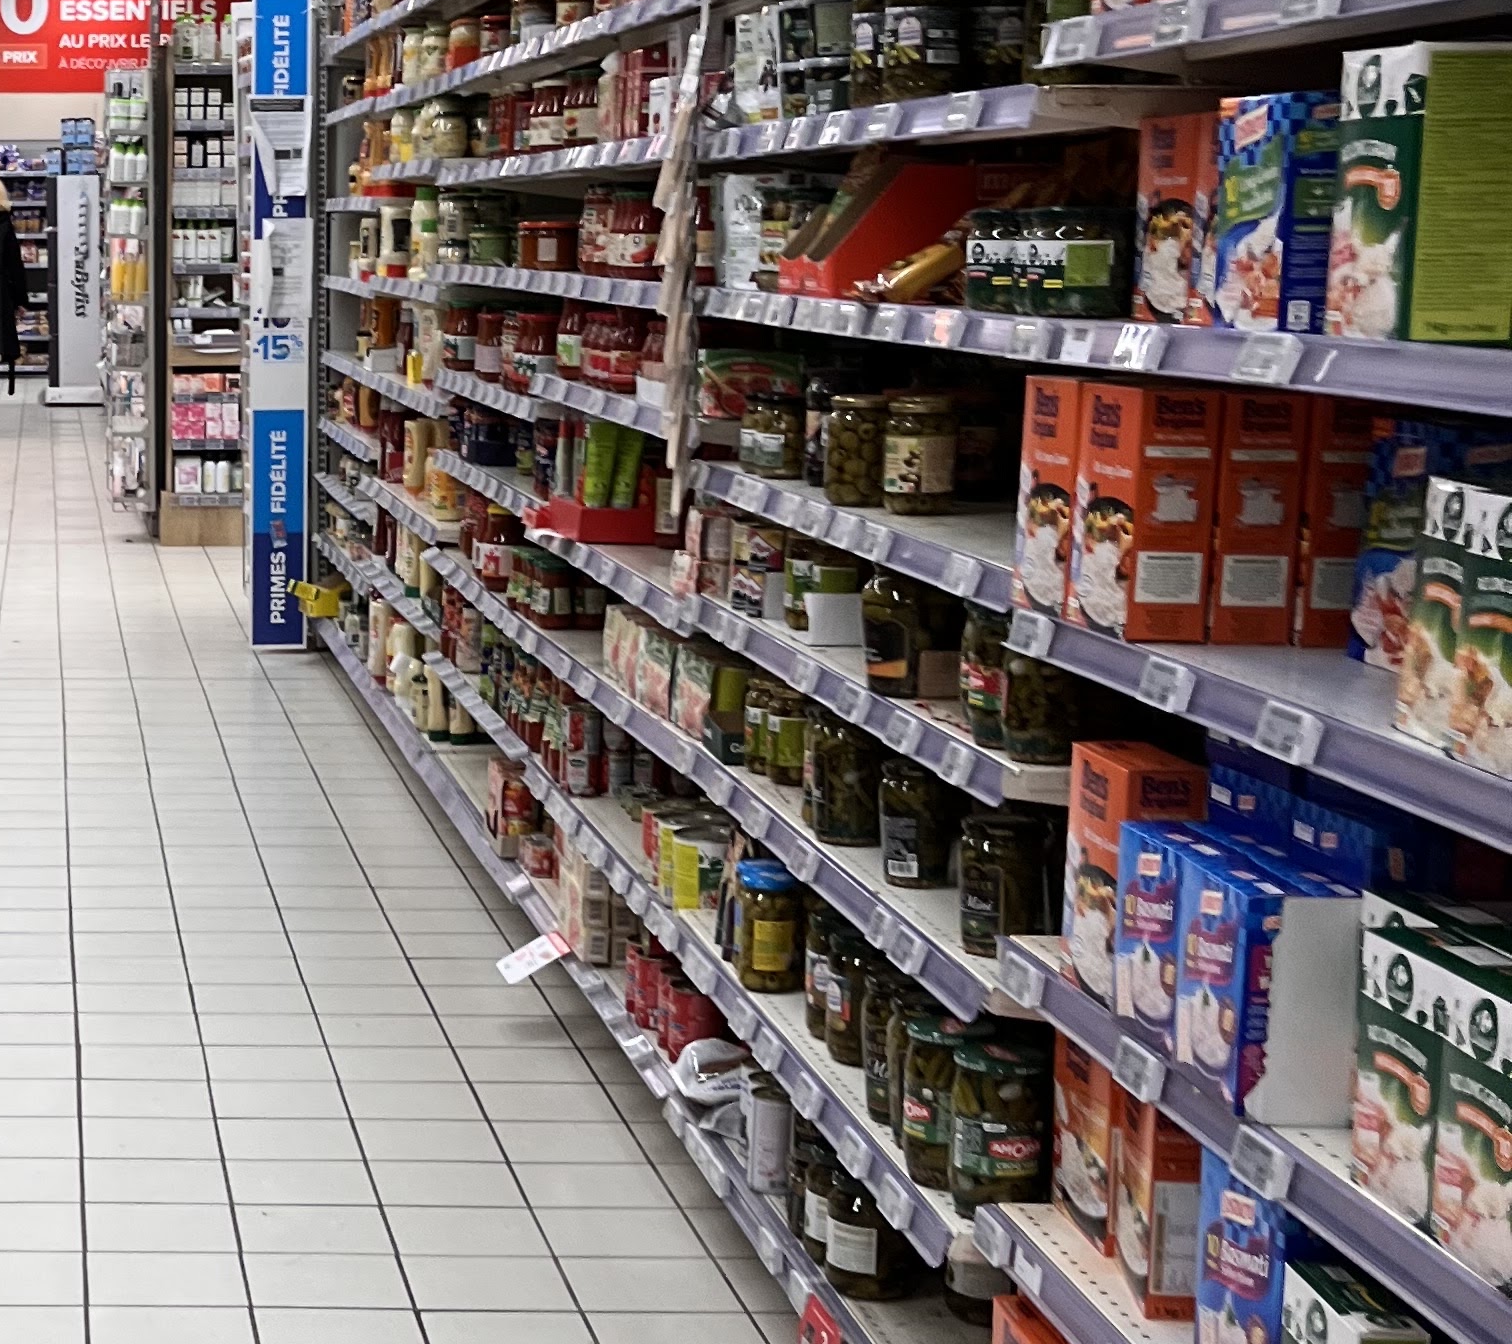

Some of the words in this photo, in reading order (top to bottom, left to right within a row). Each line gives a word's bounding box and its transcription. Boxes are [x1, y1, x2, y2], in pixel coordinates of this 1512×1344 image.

[59, 0, 217, 23] ESSENIELS
[58, 33, 85, 49] AU
[87, 33, 128, 49] PRIX
[2, 50, 38, 64] PRIX
[269, 429, 287, 514] FIDÉLITÉ
[269, 551, 287, 625] PRIMES
